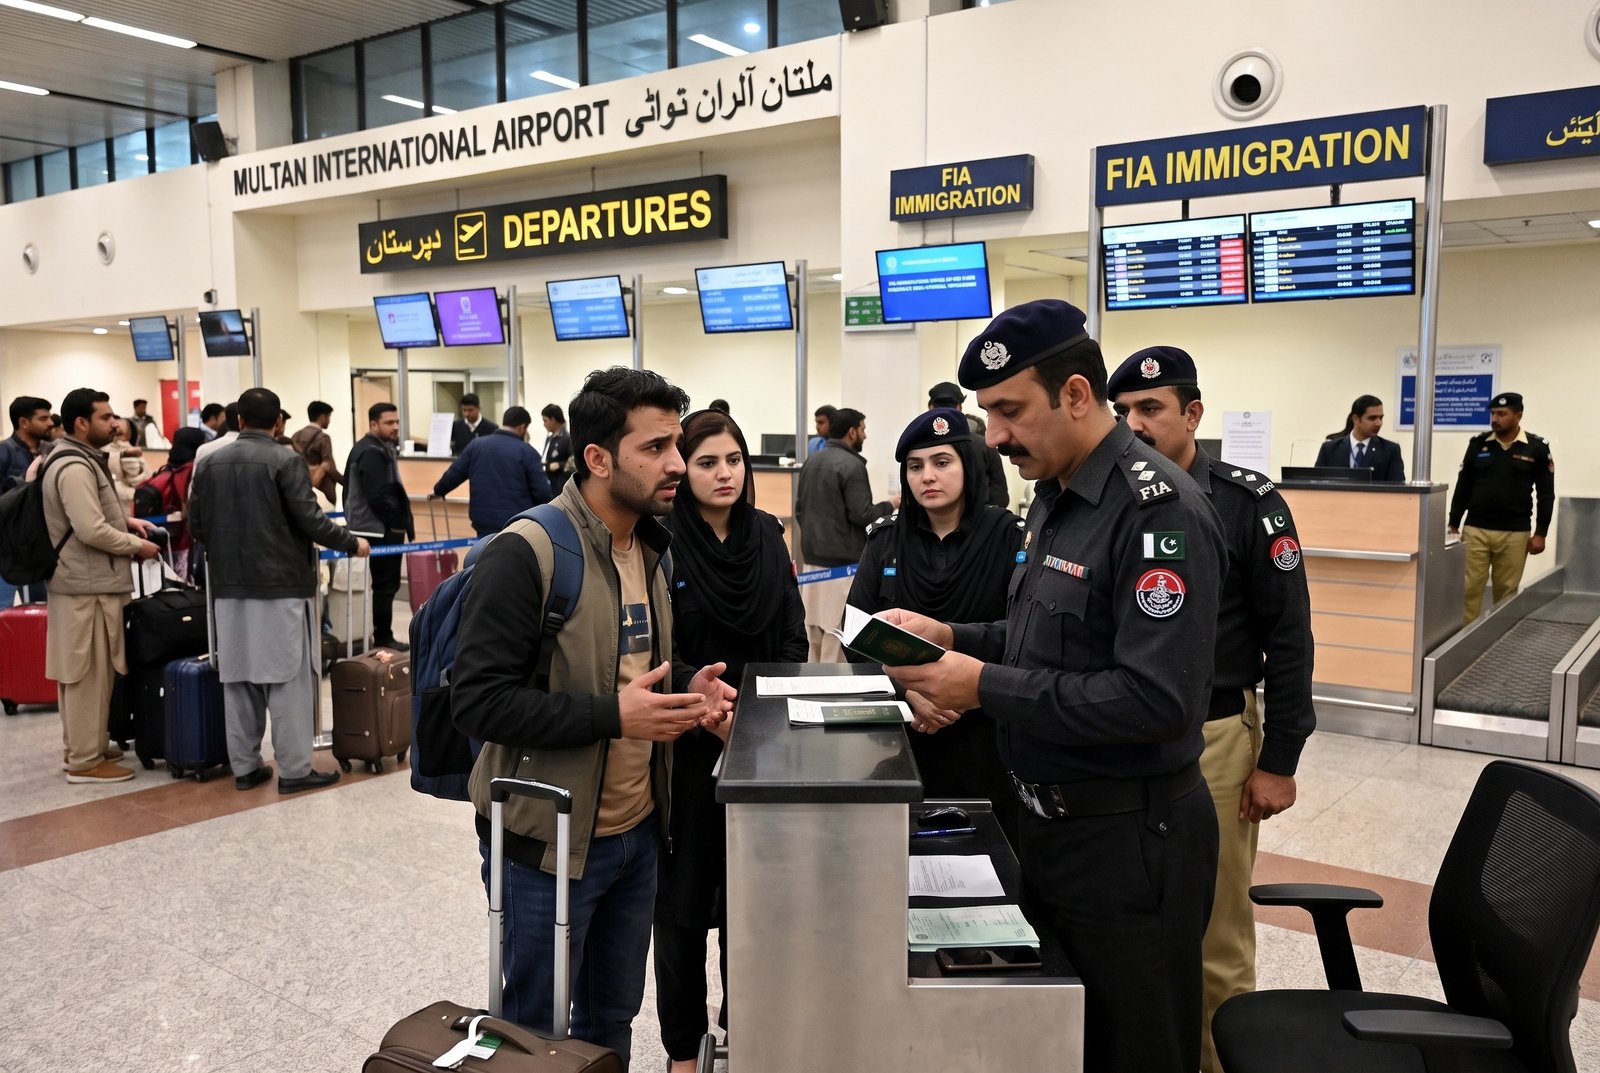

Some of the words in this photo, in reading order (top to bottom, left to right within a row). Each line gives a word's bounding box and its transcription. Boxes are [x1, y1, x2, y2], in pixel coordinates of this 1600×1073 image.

[762, 59, 833, 112] ملتان
[234, 157, 307, 196] MULTAN
[313, 127, 486, 183] INTERNATIONAL
[493, 99, 610, 153] AIRPORT
[1107, 155, 1157, 190] FIA
[1166, 124, 1410, 184] IMMIGRATION
[895, 183, 1021, 215] IMMIGRATION
[942, 166, 972, 187] FIA
[503, 189, 712, 249] DEPARTURES
[1139, 481, 1172, 501] FIA
